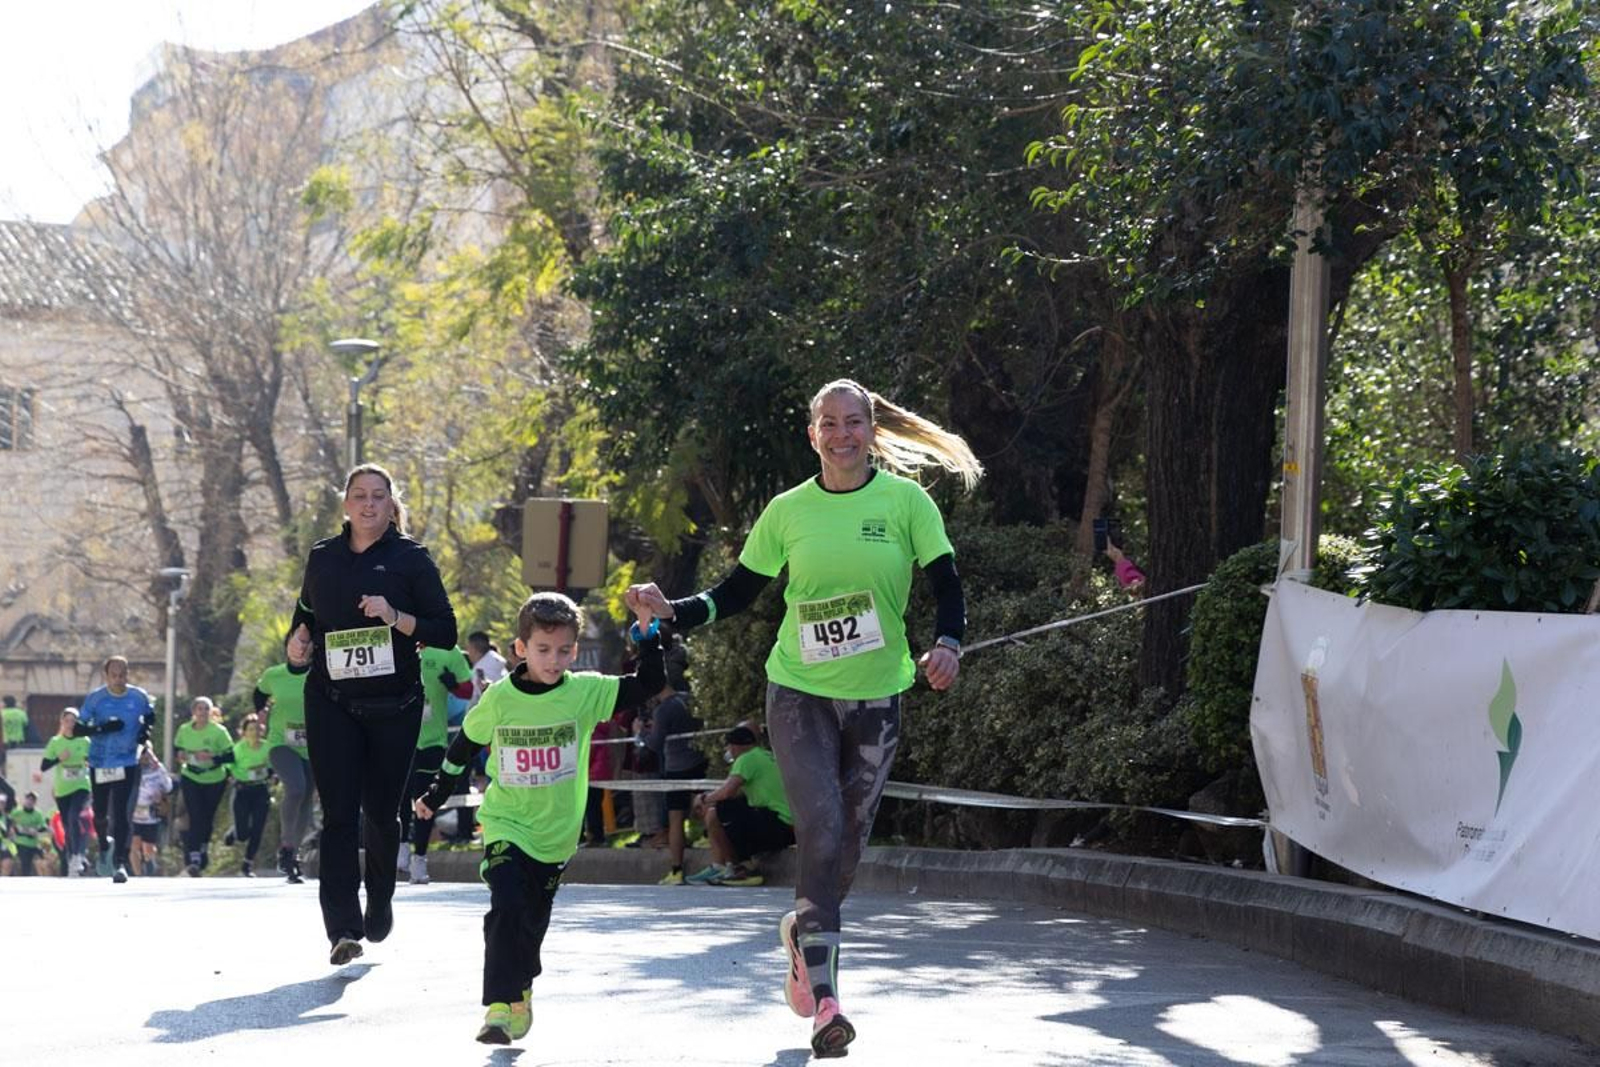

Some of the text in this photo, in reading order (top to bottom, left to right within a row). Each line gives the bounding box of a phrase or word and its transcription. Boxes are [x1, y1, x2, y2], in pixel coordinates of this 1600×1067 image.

[813, 616, 861, 646] 492
[343, 646, 375, 668] 791
[516, 746, 561, 773] 940
